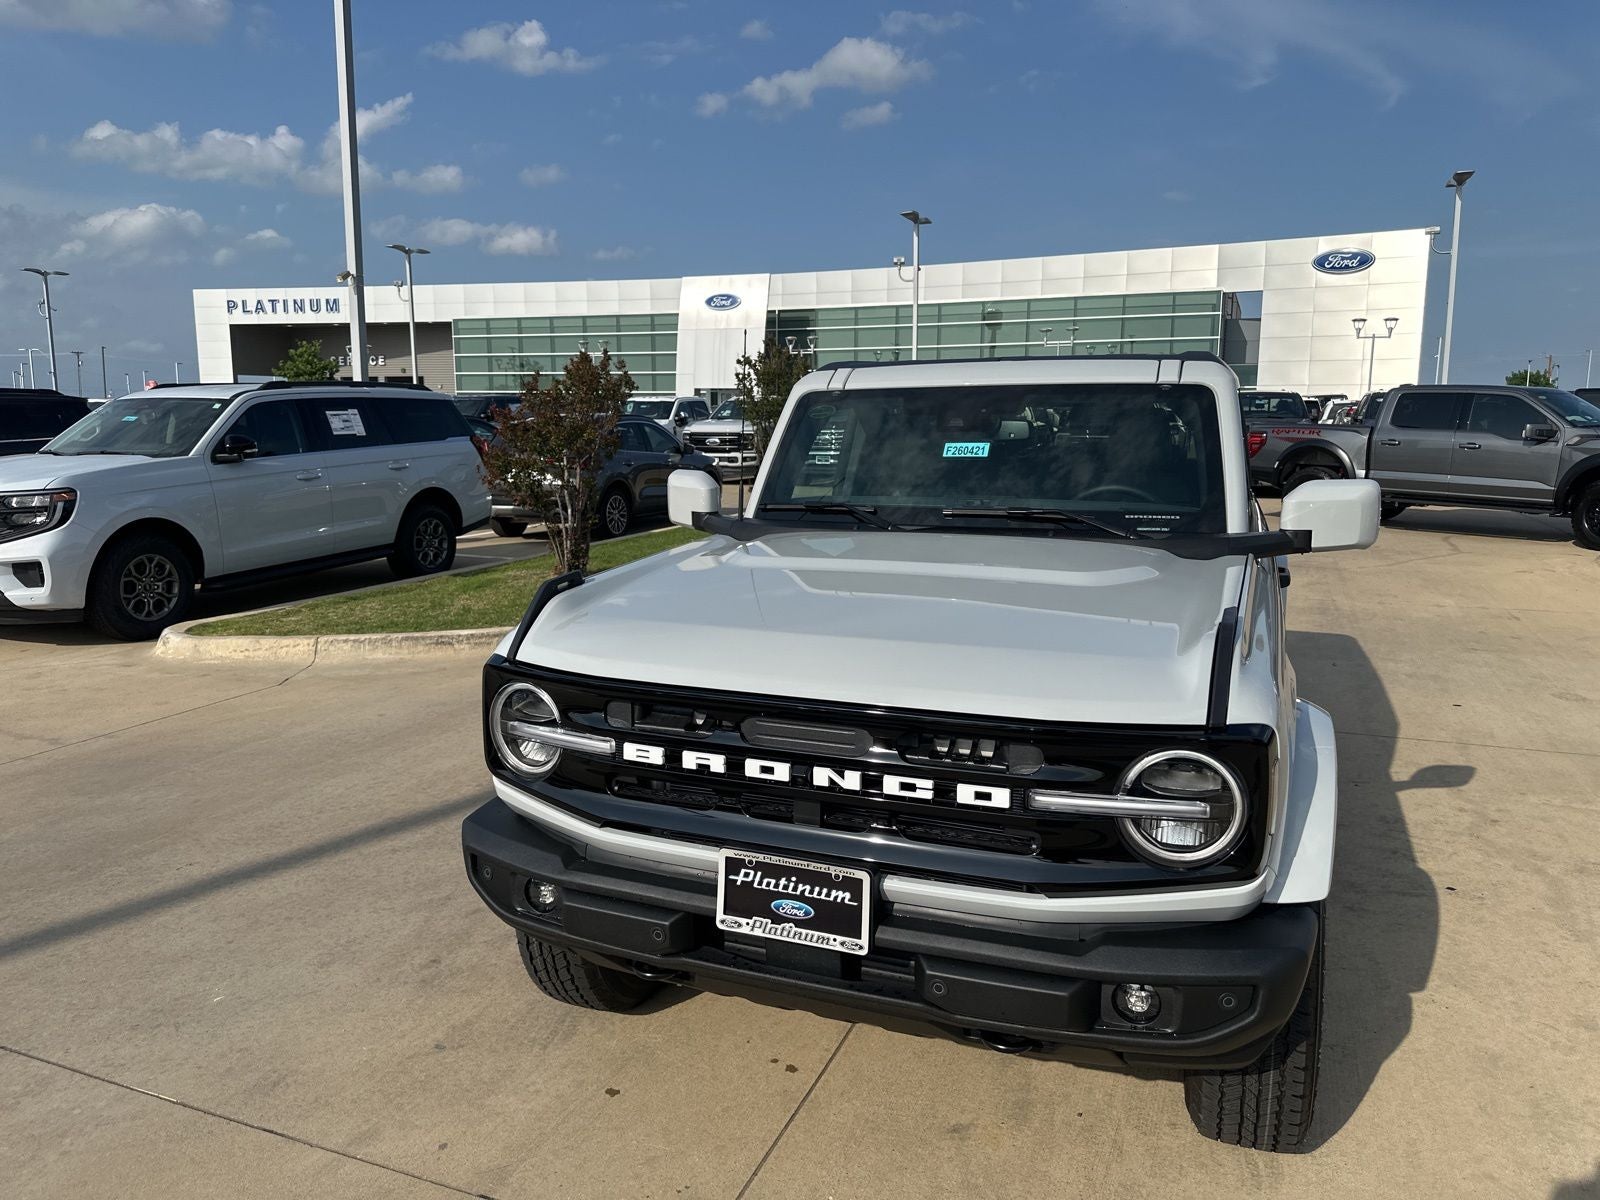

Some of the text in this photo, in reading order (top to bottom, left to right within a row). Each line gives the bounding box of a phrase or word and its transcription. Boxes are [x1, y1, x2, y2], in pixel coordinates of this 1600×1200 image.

[1324, 253, 1361, 268] Ford
[227, 298, 340, 314] PLATINUM
[945, 445, 986, 456] F260421
[623, 742, 1012, 809] BRONCO
[733, 852, 855, 876] www.PlatinumFord.com
[728, 868, 858, 906] Platinum
[779, 902, 805, 917] Ford
[750, 917, 837, 947] Platinum
